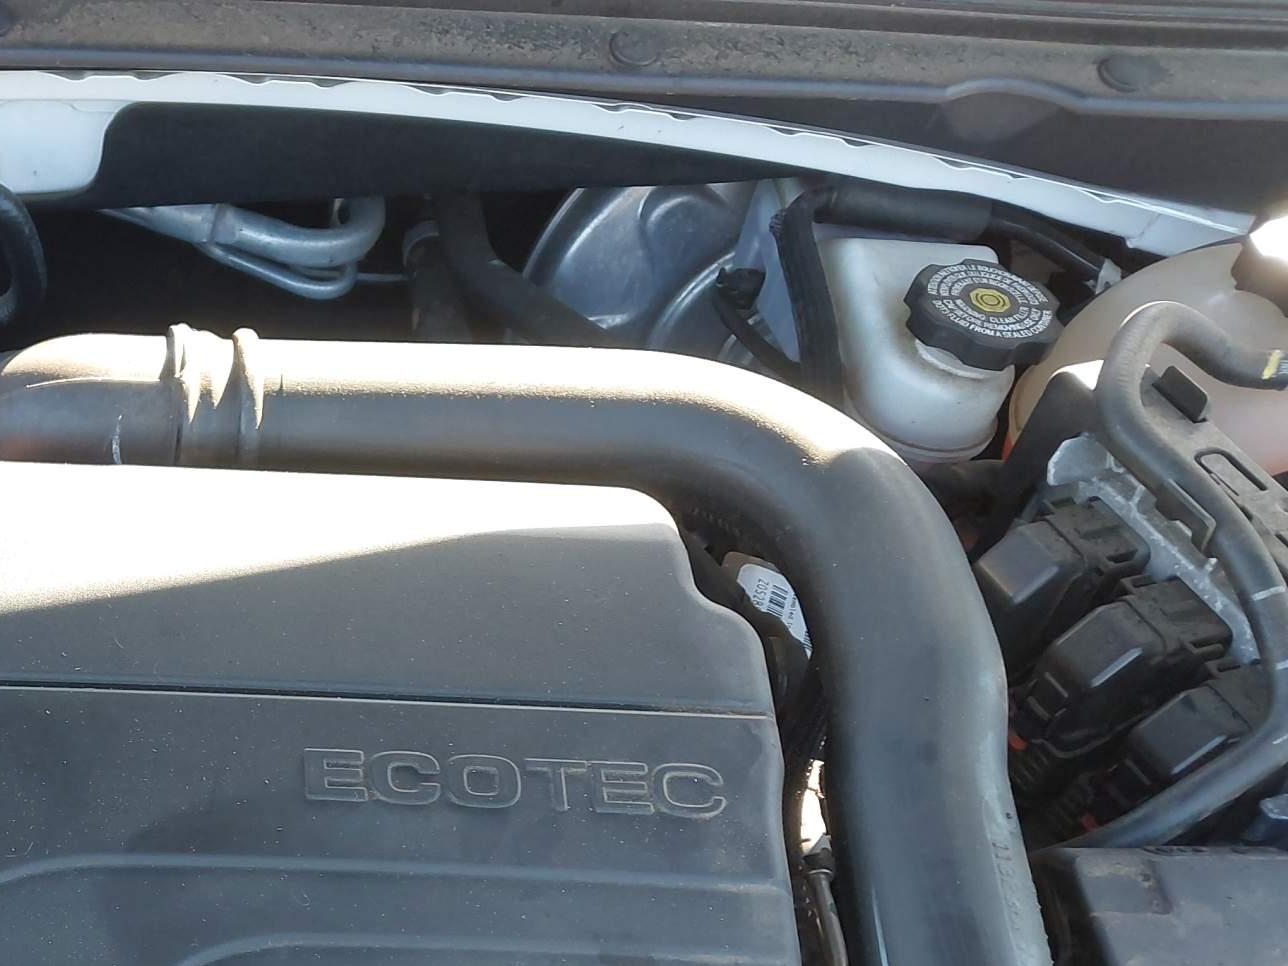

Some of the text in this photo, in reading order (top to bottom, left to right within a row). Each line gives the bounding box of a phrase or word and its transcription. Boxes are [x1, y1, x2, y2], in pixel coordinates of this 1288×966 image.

[968, 324, 995, 336] FROM
[1001, 329, 1033, 339] SEALED
[304, 748, 727, 819] ECOTEC
